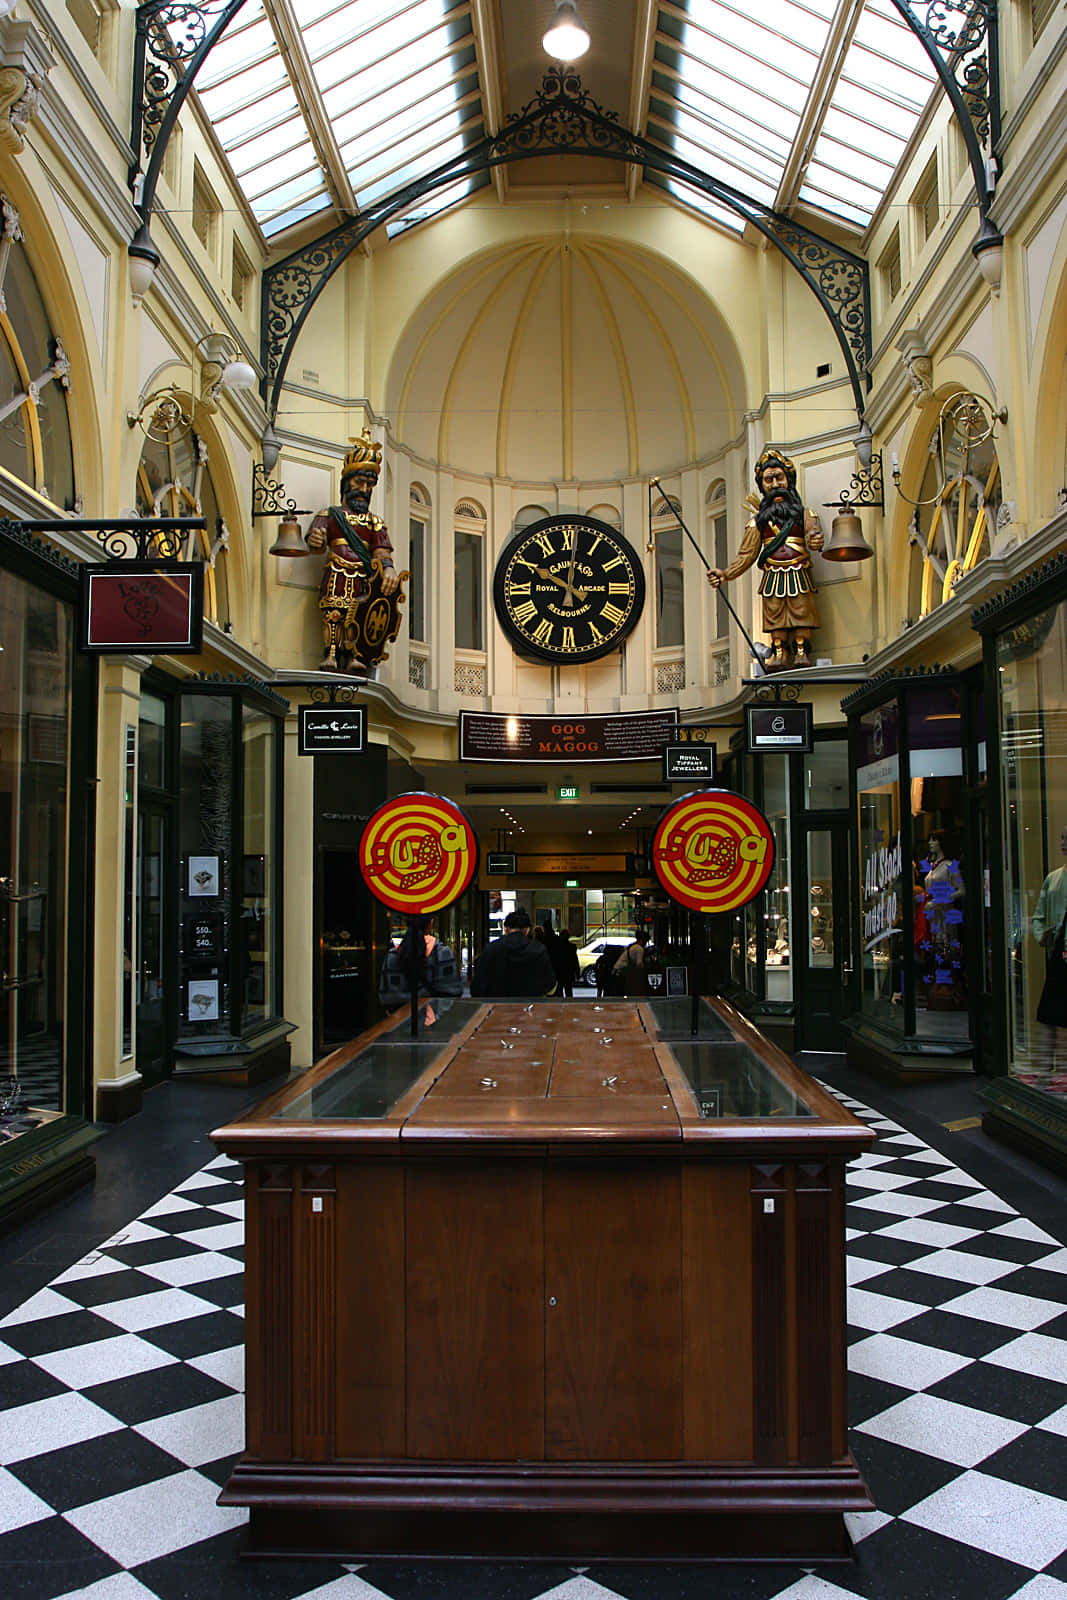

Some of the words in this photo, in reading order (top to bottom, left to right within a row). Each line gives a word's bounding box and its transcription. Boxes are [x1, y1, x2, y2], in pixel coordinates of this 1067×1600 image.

[536, 584, 559, 592] ROYAL
[608, 582, 629, 595] III
[547, 603, 592, 617] MELBOURNE
[552, 724, 586, 734] GOG
[538, 742, 599, 752] MAGOG
[560, 788, 576, 797] EXIT
[879, 829, 902, 890] Stock
